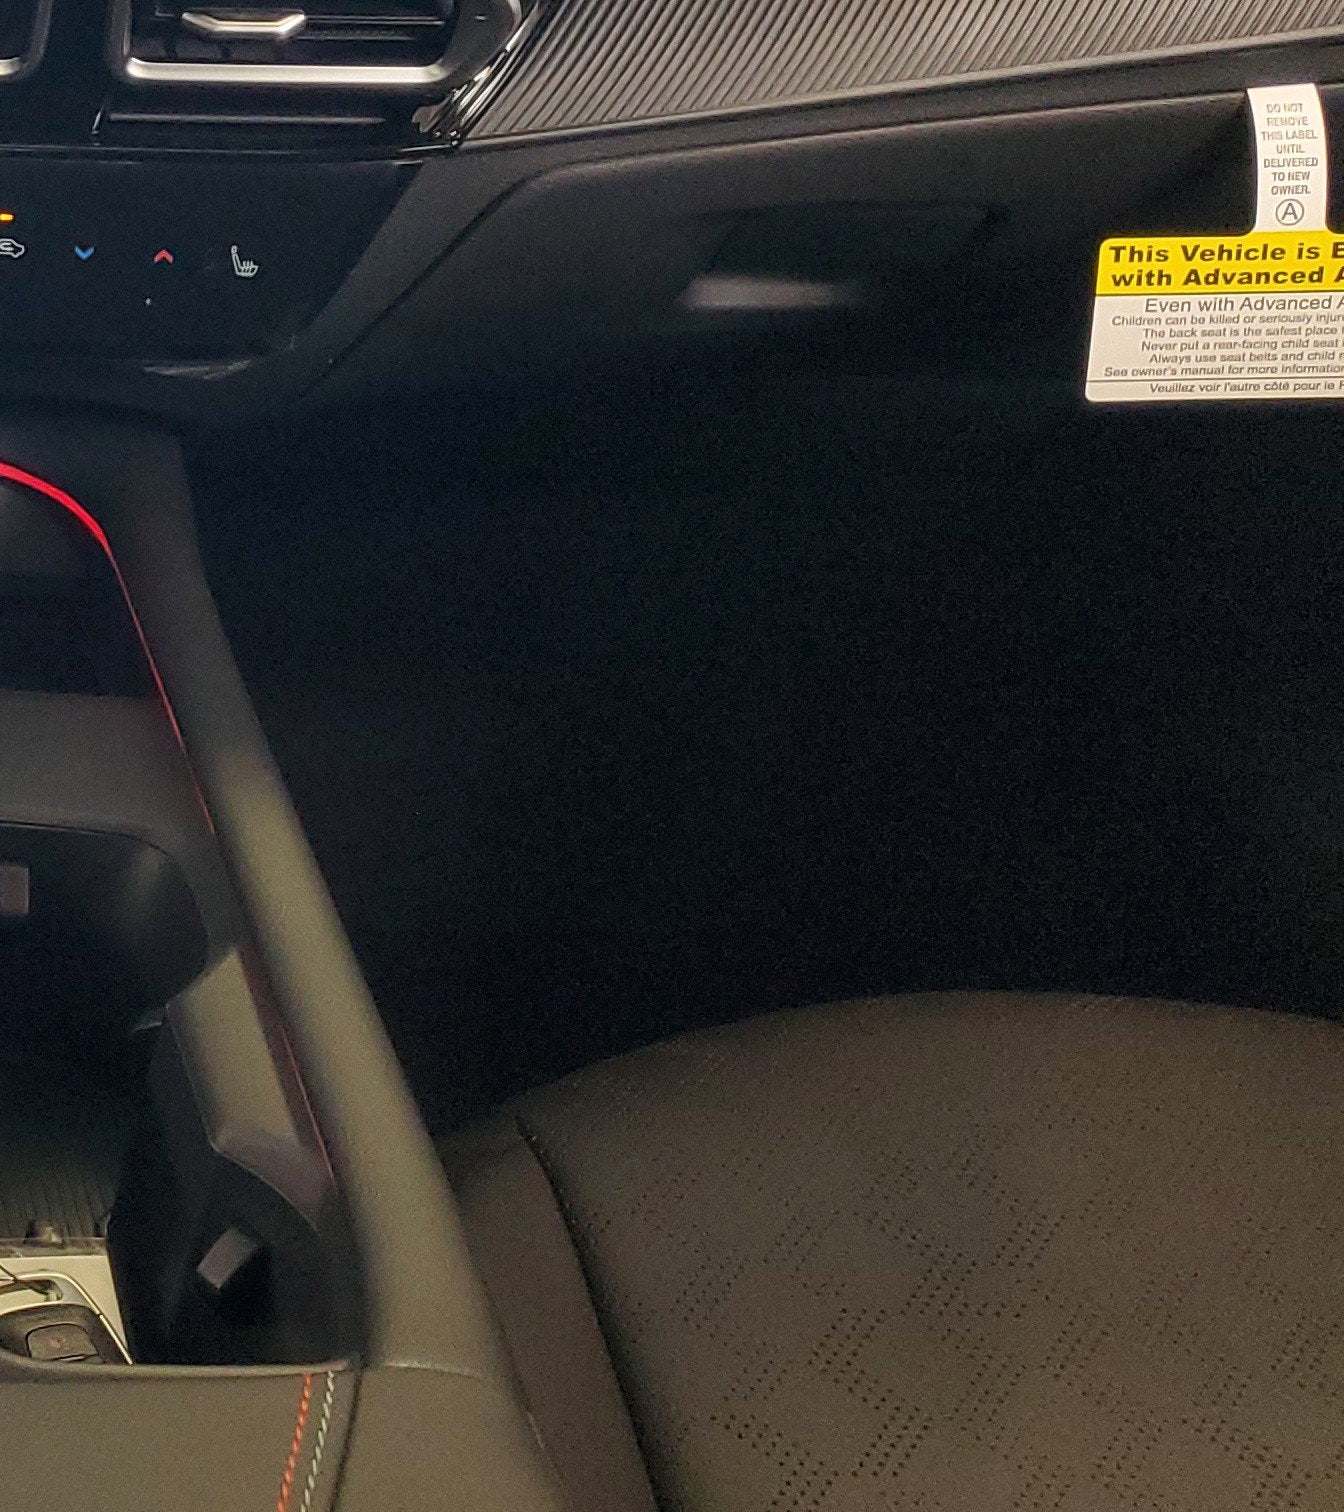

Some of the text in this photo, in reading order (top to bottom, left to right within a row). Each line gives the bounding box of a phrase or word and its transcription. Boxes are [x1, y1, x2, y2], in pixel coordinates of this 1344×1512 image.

[1266, 103, 1303, 113] DO NOT
[1267, 116, 1308, 126] REMOVE
[1261, 129, 1318, 141] THIS LABEL
[1276, 144, 1305, 154] UNTIL
[1263, 157, 1318, 168] DELIVERED
[1272, 171, 1310, 181] TO NEW
[1271, 185, 1311, 195] OWNER.
[1281, 202, 1298, 220] A
[1109, 245, 1169, 263] This
[1181, 243, 1287, 262] Vehicle
[1297, 242, 1321, 260] is
[1112, 269, 1172, 286] with
[1182, 266, 1324, 286] Advanced
[1145, 298, 1191, 313] Even
[1198, 296, 1234, 312] with
[1239, 295, 1332, 311] Advanced
[1112, 315, 1162, 326] Children
[1165, 317, 1187, 325] can
[1190, 315, 1205, 324] be
[1209, 314, 1240, 324] killed
[1243, 315, 1256, 324] or
[1259, 313, 1312, 324] seriously
[1143, 325, 1338, 338] The back seat is the safest place
[1141, 338, 1338, 352] Never put a rear-facing child seat
[1149, 351, 1335, 365] Always use seat belts and child
[1104, 367, 1128, 377] See
[1131, 366, 1177, 377] owner's
[1180, 365, 1224, 376] manual
[1228, 365, 1244, 375] for
[1247, 366, 1278, 375] more
[1149, 383, 1195, 393] Veuillez
[1199, 382, 1221, 392] voir
[1293, 382, 1321, 392] pour
[1324, 381, 1335, 390] le
